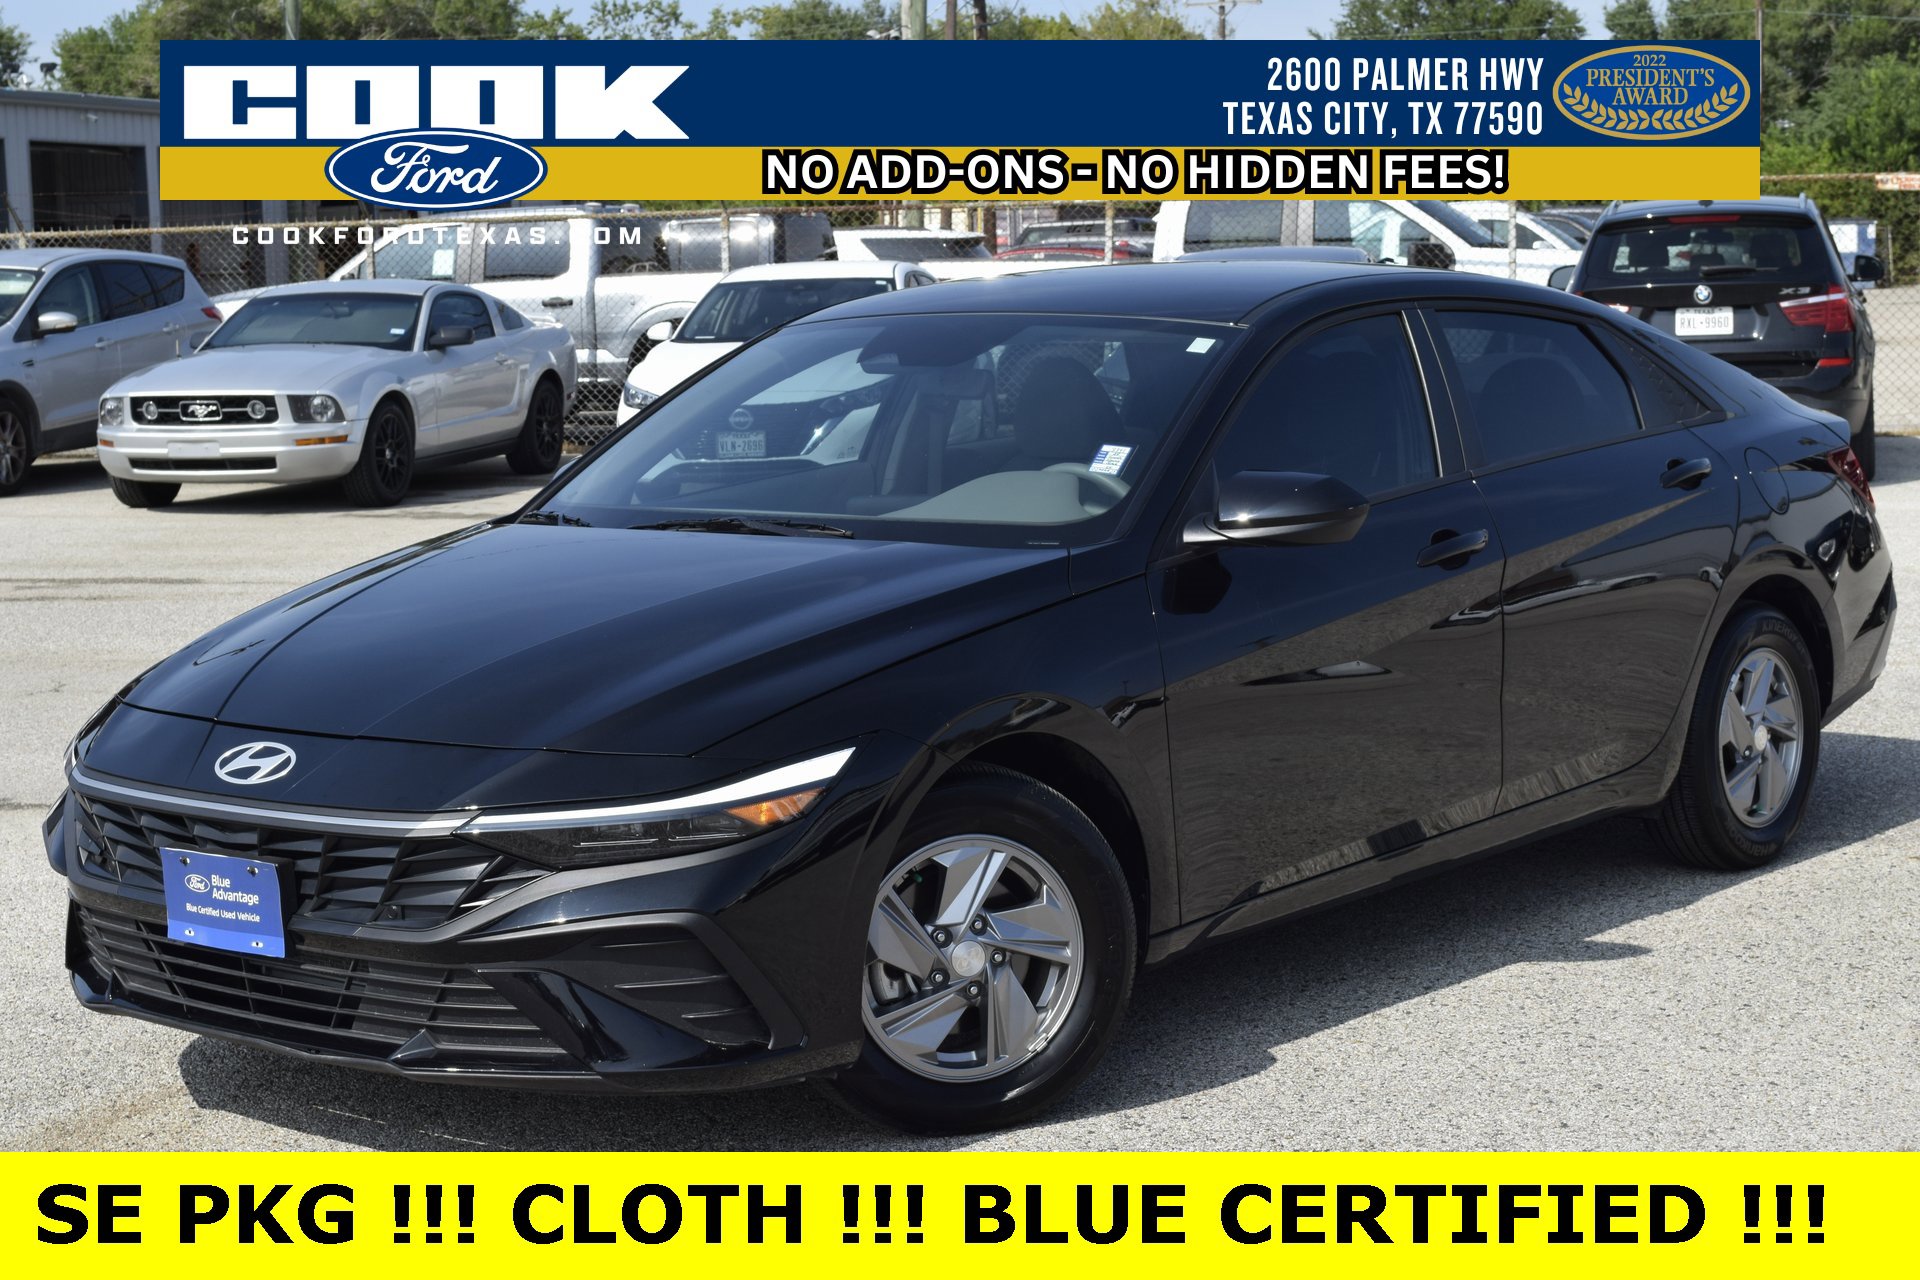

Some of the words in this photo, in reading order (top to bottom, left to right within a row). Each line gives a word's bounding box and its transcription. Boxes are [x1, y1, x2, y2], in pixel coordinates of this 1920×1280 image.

[1779, 287, 1811, 295] X3
[211, 874, 230, 887] Blue
[212, 888, 258, 905] Advantage
[186, 903, 198, 913] Blue
[198, 905, 220, 917] Certified
[221, 908, 236, 919] Used
[237, 912, 260, 922] Vehicle
